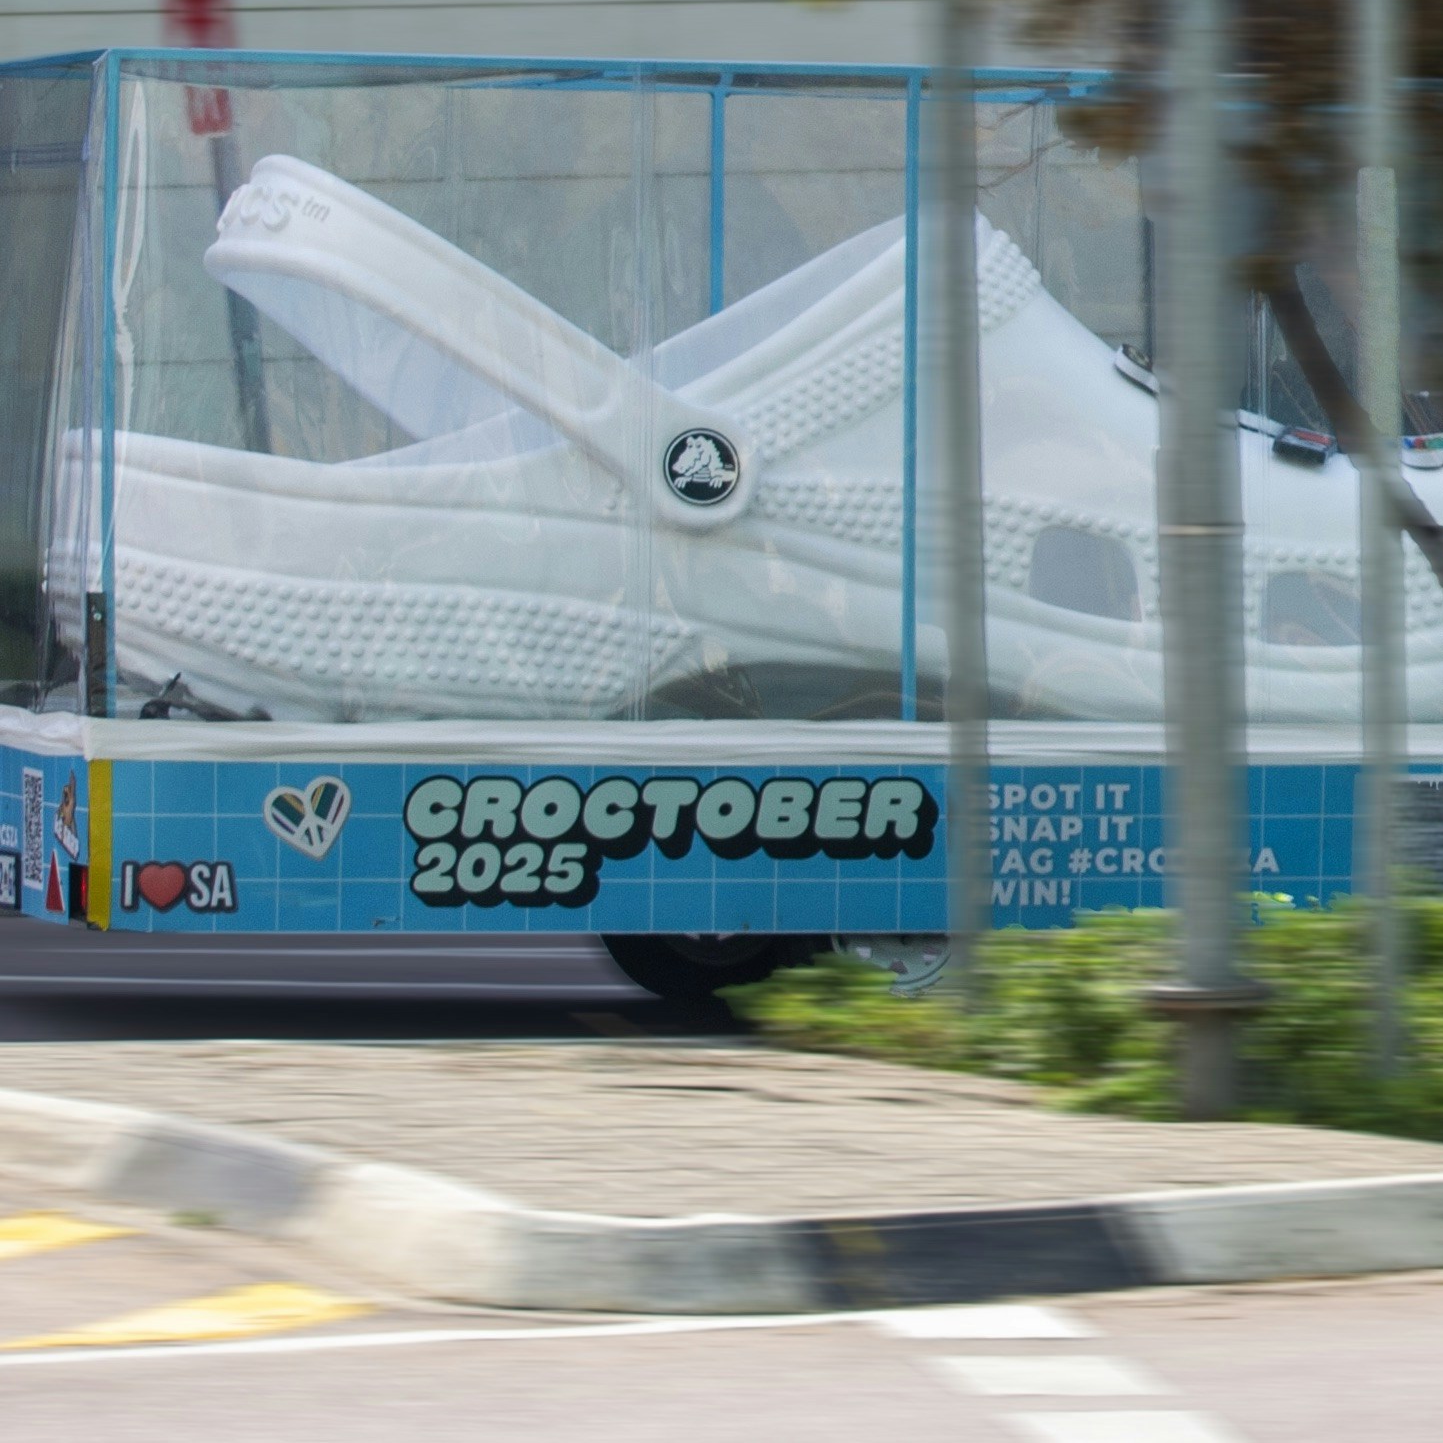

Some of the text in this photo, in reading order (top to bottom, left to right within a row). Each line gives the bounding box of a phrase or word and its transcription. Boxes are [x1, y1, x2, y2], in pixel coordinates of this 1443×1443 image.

[405, 776, 930, 847] CROCTOBER
[1095, 784, 1131, 810] IT
[1099, 815, 1134, 842] IT
[123, 862, 234, 908] I SA
[411, 841, 592, 899] 2025
